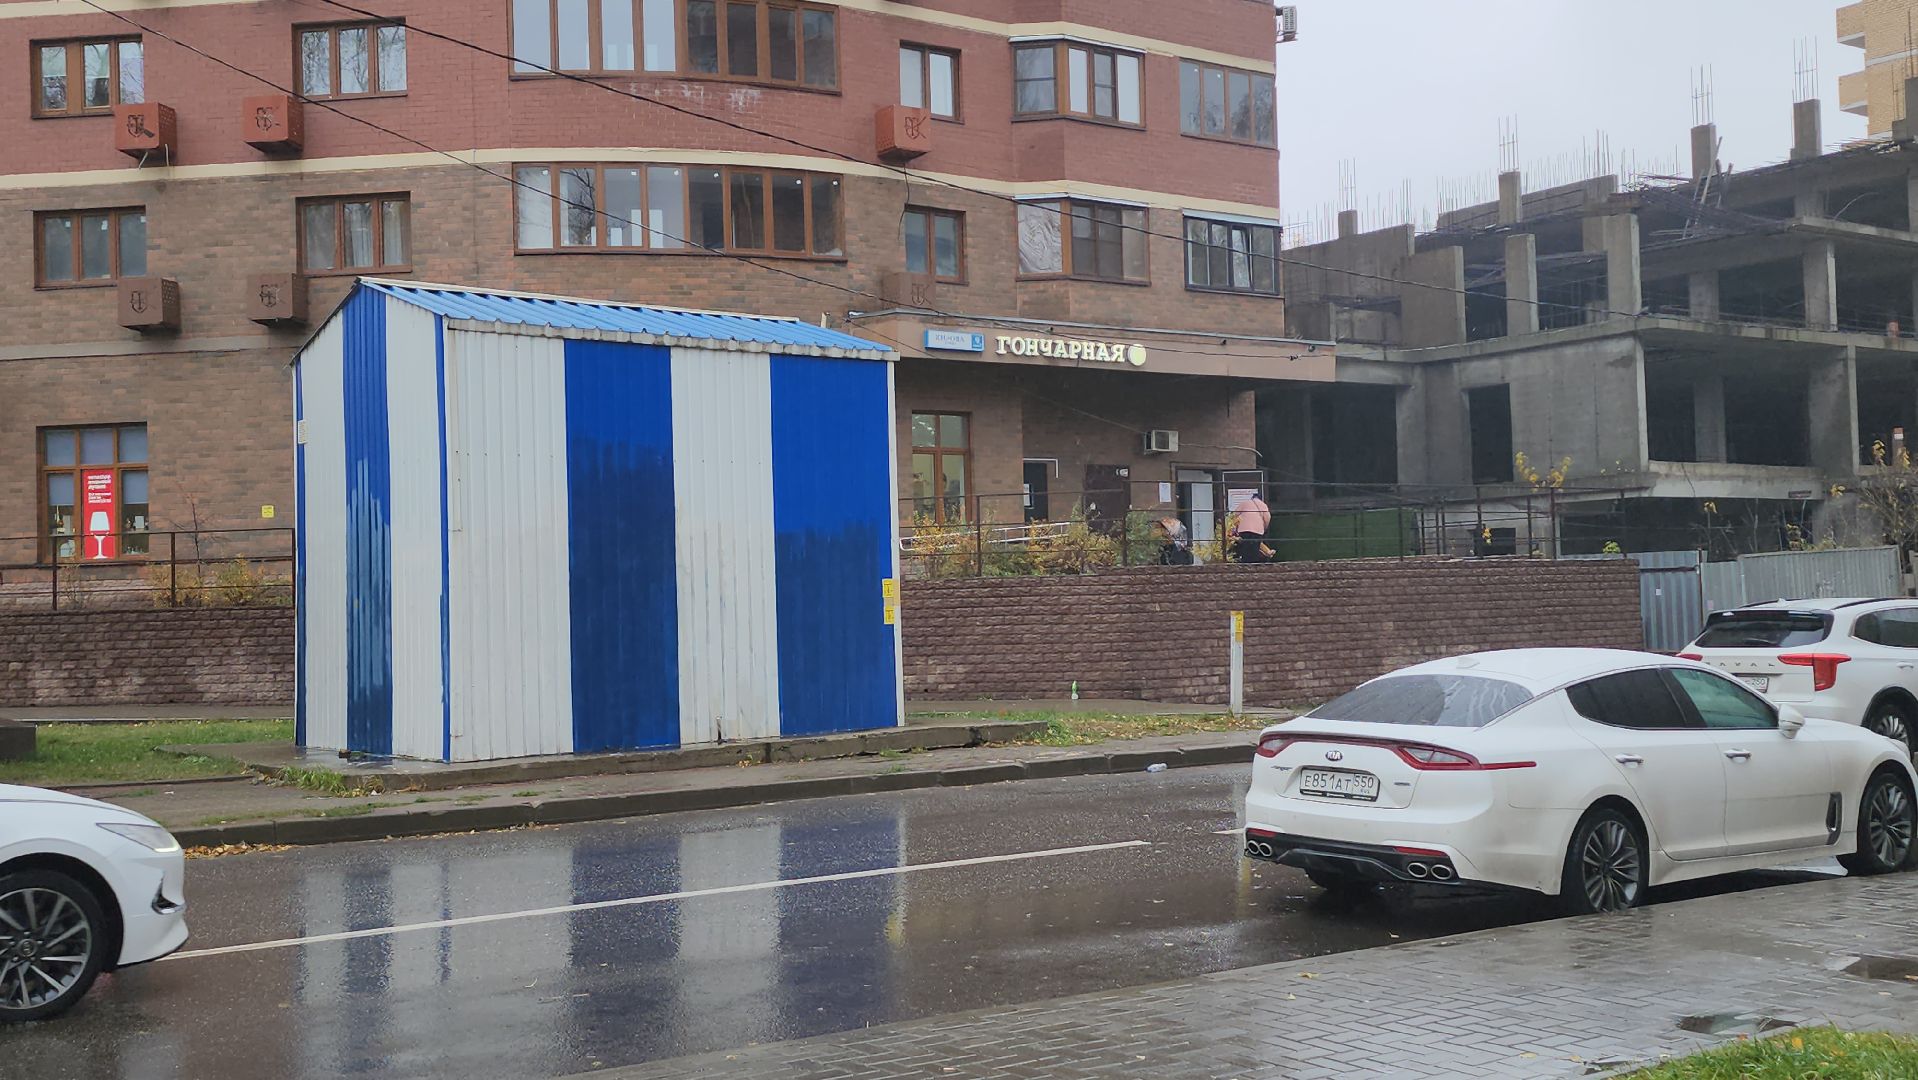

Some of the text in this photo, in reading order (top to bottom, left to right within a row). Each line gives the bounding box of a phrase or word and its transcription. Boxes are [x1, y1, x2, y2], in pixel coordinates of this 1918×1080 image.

[995, 336, 1126, 363] ГОНЧАРНАЯ
[1326, 750, 1342, 761] KIA
[1353, 775, 1374, 789] 550
